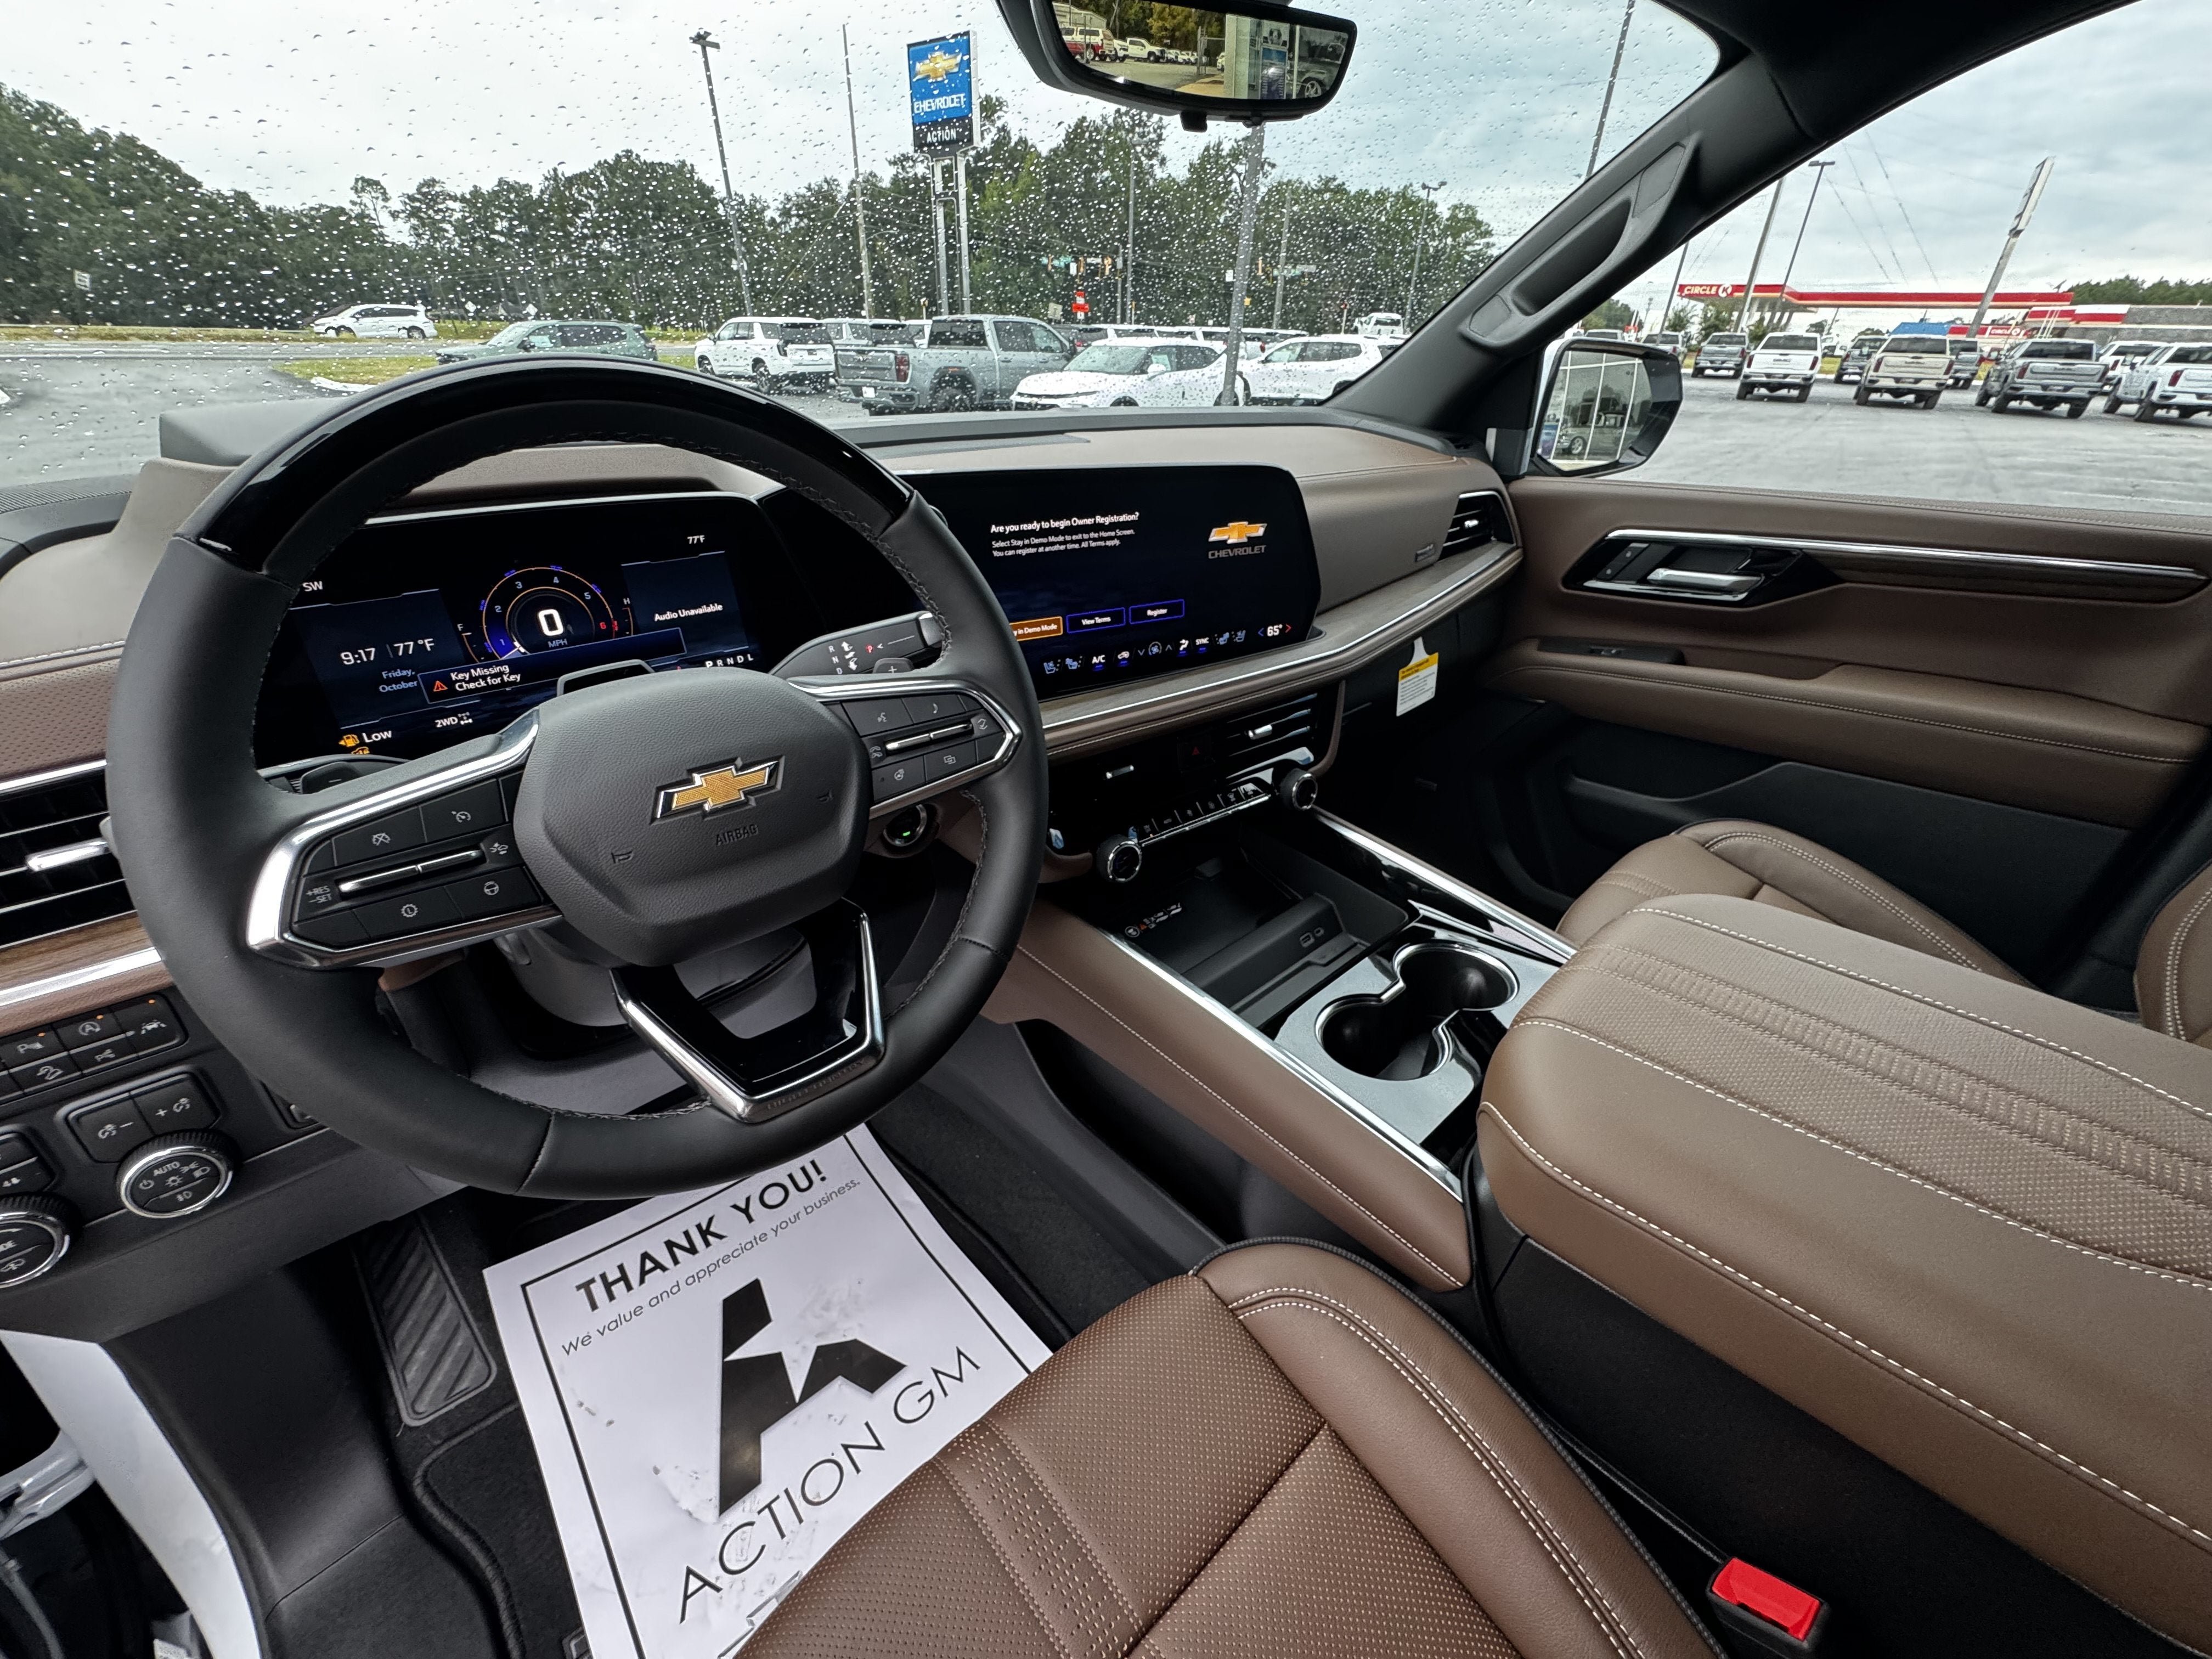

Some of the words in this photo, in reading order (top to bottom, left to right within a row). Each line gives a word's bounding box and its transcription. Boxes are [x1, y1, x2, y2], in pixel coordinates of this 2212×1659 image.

[914, 93, 966, 114] CHEVROLET
[927, 128, 957, 144] ACTION
[1684, 286, 1718, 295] CIRCLE
[990, 524, 1005, 533] Are
[1005, 525, 1019, 534] you
[1020, 521, 1041, 531] ready
[1050, 519, 1071, 529] begin
[1071, 517, 1095, 526] Owner
[1096, 511, 1139, 525] Registration?
[1011, 539, 1024, 547] Stay
[1030, 537, 1048, 545] Demo
[1016, 547, 1037, 556] register
[1105, 538, 1121, 546] apply.
[1208, 545, 1266, 559] CHEVROLET
[302, 580, 323, 592] SW
[516, 581, 523, 589] 3
[494, 605, 503, 613] 2
[584, 591, 591, 600] 5
[623, 597, 631, 605] H
[654, 611, 679, 622] Audio
[679, 603, 724, 618] Unavailable
[1147, 607, 1168, 617] Register
[457, 623, 464, 631] F
[537, 608, 565, 636] 0
[547, 637, 568, 648] MPH
[1195, 637, 1210, 645] SYNC
[340, 647, 376, 665] 9:17
[726, 657, 734, 665] N
[736, 655, 744, 663] D
[747, 653, 754, 661] L
[832, 656, 839, 664] N
[1091, 654, 1106, 664] A/C
[450, 670, 471, 682] Key
[471, 663, 510, 678] Missing
[379, 679, 418, 693] October
[455, 679, 487, 692] Check
[487, 676, 503, 686] for
[503, 672, 521, 685] Key
[435, 716, 458, 729] 2WD
[362, 729, 392, 743] Low
[715, 824, 758, 846] AIRBAG
[153, 1161, 180, 1177] AUTO
[575, 1215, 728, 1312] THANK
[730, 1159, 827, 1224] YOU!
[561, 1334, 592, 1356] We
[596, 1303, 644, 1338] value
[648, 1282, 681, 1309] and
[685, 1229, 768, 1290] appreciate
[770, 1210, 803, 1237] your
[805, 1178, 861, 1214] business.
[679, 1420, 885, 1624] ACTION
[892, 1346, 981, 1424] GM
